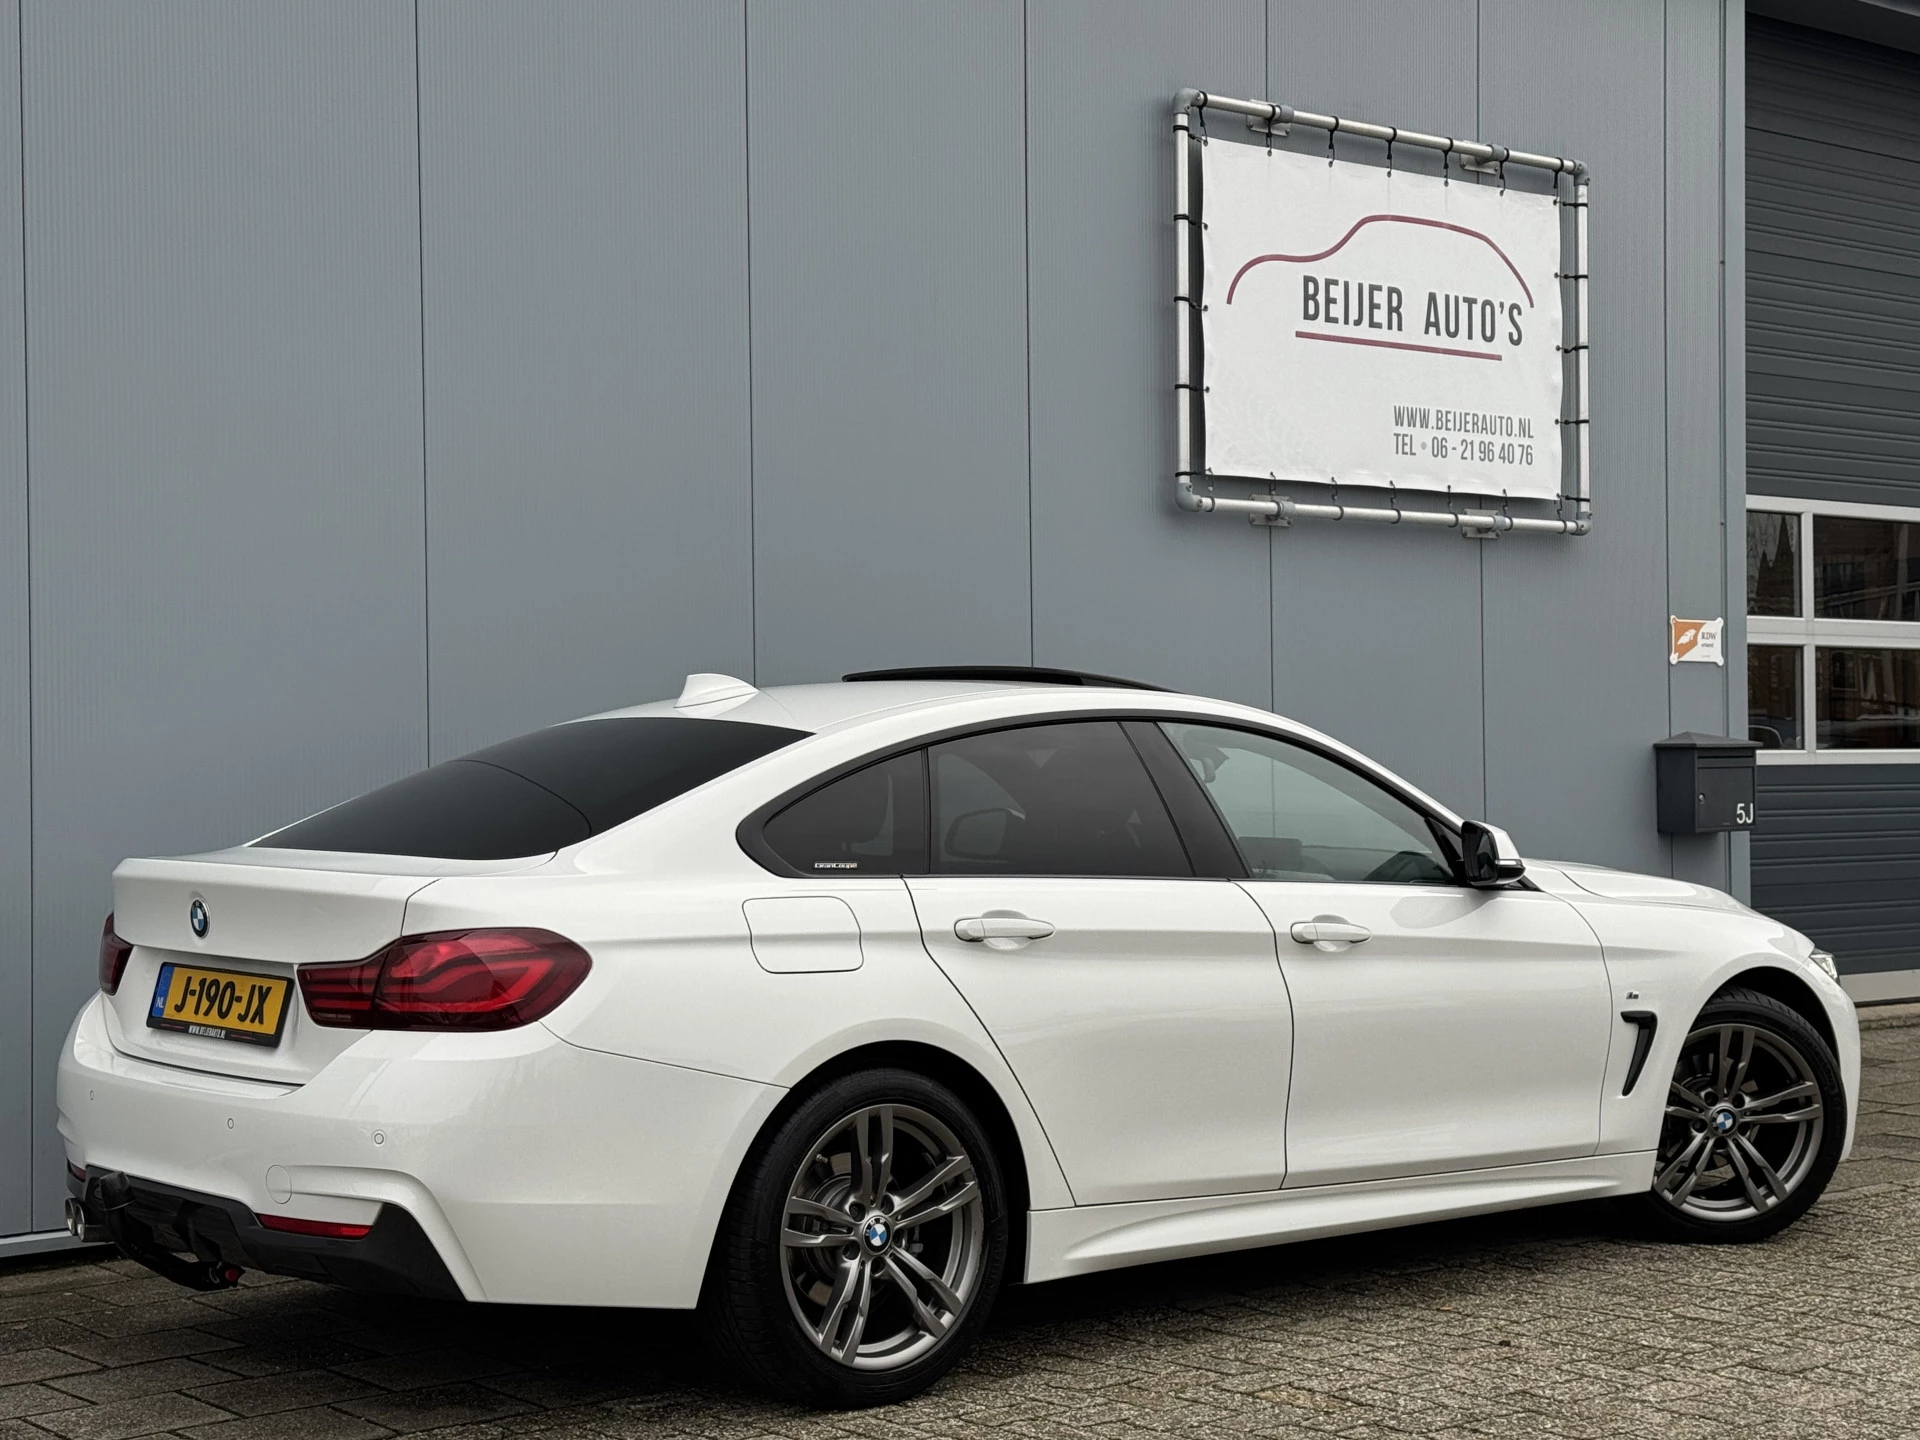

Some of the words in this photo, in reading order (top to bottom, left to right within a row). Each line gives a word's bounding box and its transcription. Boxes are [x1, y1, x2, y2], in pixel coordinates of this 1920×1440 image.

[1303, 275, 1403, 332] BEIJER
[1424, 291, 1523, 346] AUTO'S
[1393, 405, 1534, 439] WWW.BEIJERAUTO.NL
[1393, 432, 1416, 456] TEL
[1431, 436, 1448, 459] 06
[1478, 440, 1495, 462] 96
[1498, 442, 1514, 464] 40
[1517, 443, 1533, 466] 76
[1736, 803, 1753, 824] 5J
[156, 996, 164, 1008] NL
[174, 976, 272, 1025] J-190-JX
